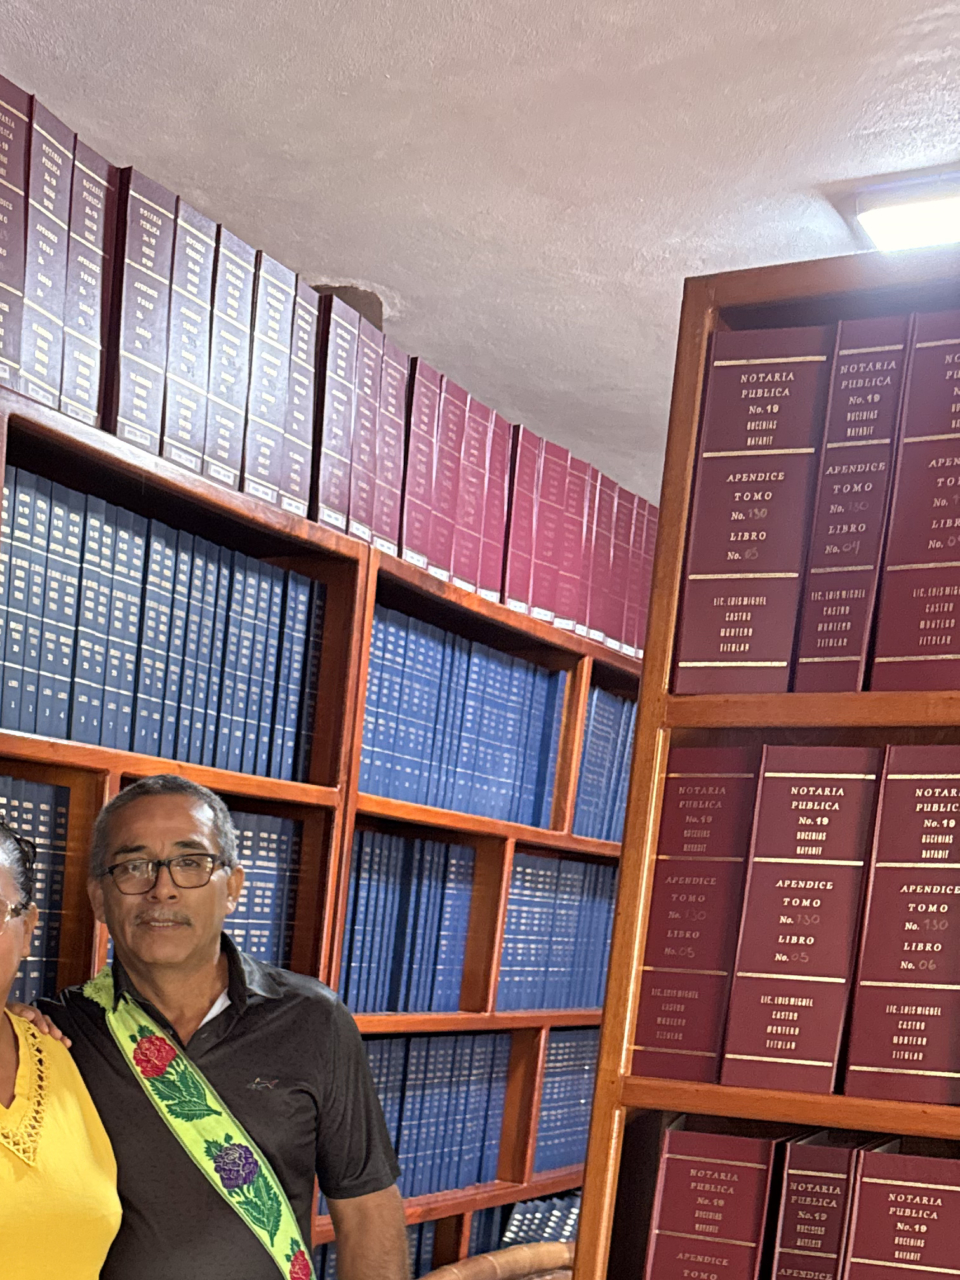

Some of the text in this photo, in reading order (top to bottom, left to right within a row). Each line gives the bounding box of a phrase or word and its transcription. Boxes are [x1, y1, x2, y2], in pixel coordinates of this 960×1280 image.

[840, 361, 897, 374] NOTARIA
[741, 372, 794, 383] NOTARIA
[841, 376, 891, 389] PUBLICA
[741, 388, 790, 398] PUBLICA
[849, 394, 880, 405] No. 19
[749, 404, 779, 414] No. 19
[826, 462, 886, 475] APENDICE
[726, 472, 785, 482] APENDICE
[833, 483, 873, 493] TOMO
[734, 492, 772, 501] TOMO
[830, 504, 844, 513] No.
[731, 511, 745, 520] No.
[932, 518, 960, 529] LIBR
[828, 523, 866, 534] LIBRO
[730, 532, 766, 541] LIBRO
[825, 545, 839, 554] No.
[727, 551, 741, 560] No.
[791, 787, 844, 796] NOTARIA
[915, 789, 960, 797] NOTAR
[791, 802, 840, 810] PUBLICA
[916, 804, 960, 812] PUBLIC
[799, 817, 829, 825] No. 19
[923, 820, 939, 828] No.
[775, 880, 833, 889] APENDICE
[900, 885, 960, 894] APENDICE
[672, 894, 706, 902] TOMO
[783, 898, 821, 907] TOMO
[908, 904, 948, 912] TOMO
[780, 916, 794, 924] No.
[778, 935, 814, 944] LIBRO
[904, 943, 942, 951] LIBRO
[775, 953, 789, 961] No.
[900, 961, 915, 969] No.
[690, 1169, 739, 1181] NOTARIA
[690, 1183, 734, 1194] PUBLICA
[790, 1182, 841, 1194] NOTARIA
[791, 1196, 837, 1208] PUBLICA
[888, 1194, 942, 1206] NOTARIA
[889, 1207, 938, 1219] PUBLICA
[896, 1222, 927, 1233] No. 19
[677, 1253, 729, 1266] APENDICE
[683, 1270, 718, 1280] TOMO
[778, 1269, 832, 1280] APENDICE
